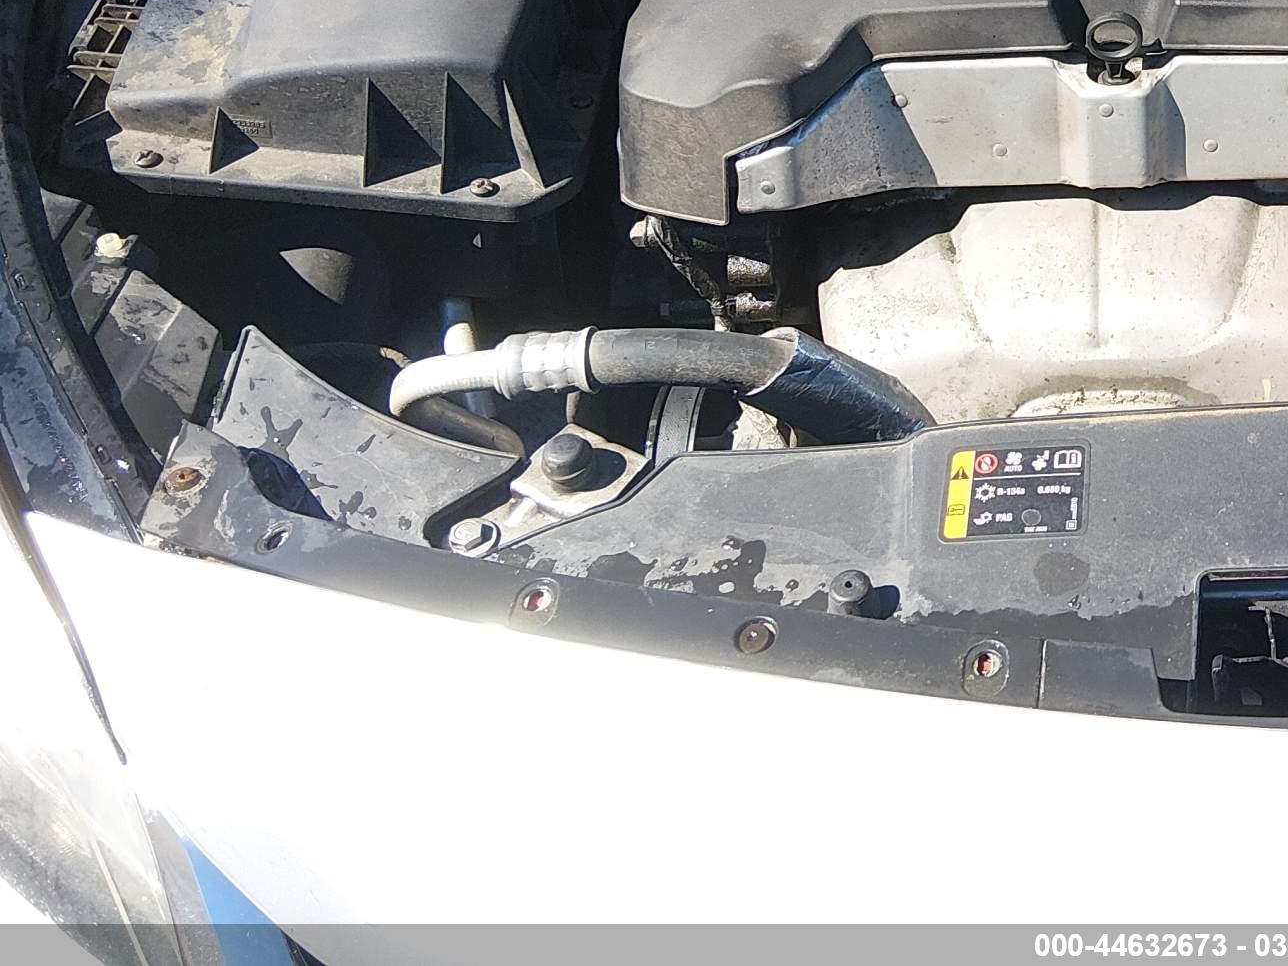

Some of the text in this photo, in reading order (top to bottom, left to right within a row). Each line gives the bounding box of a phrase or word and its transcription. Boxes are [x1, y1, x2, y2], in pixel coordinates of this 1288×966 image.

[1004, 465, 1023, 473] AUTO
[996, 486, 1026, 496] R-134a
[996, 513, 1013, 522] PAG
